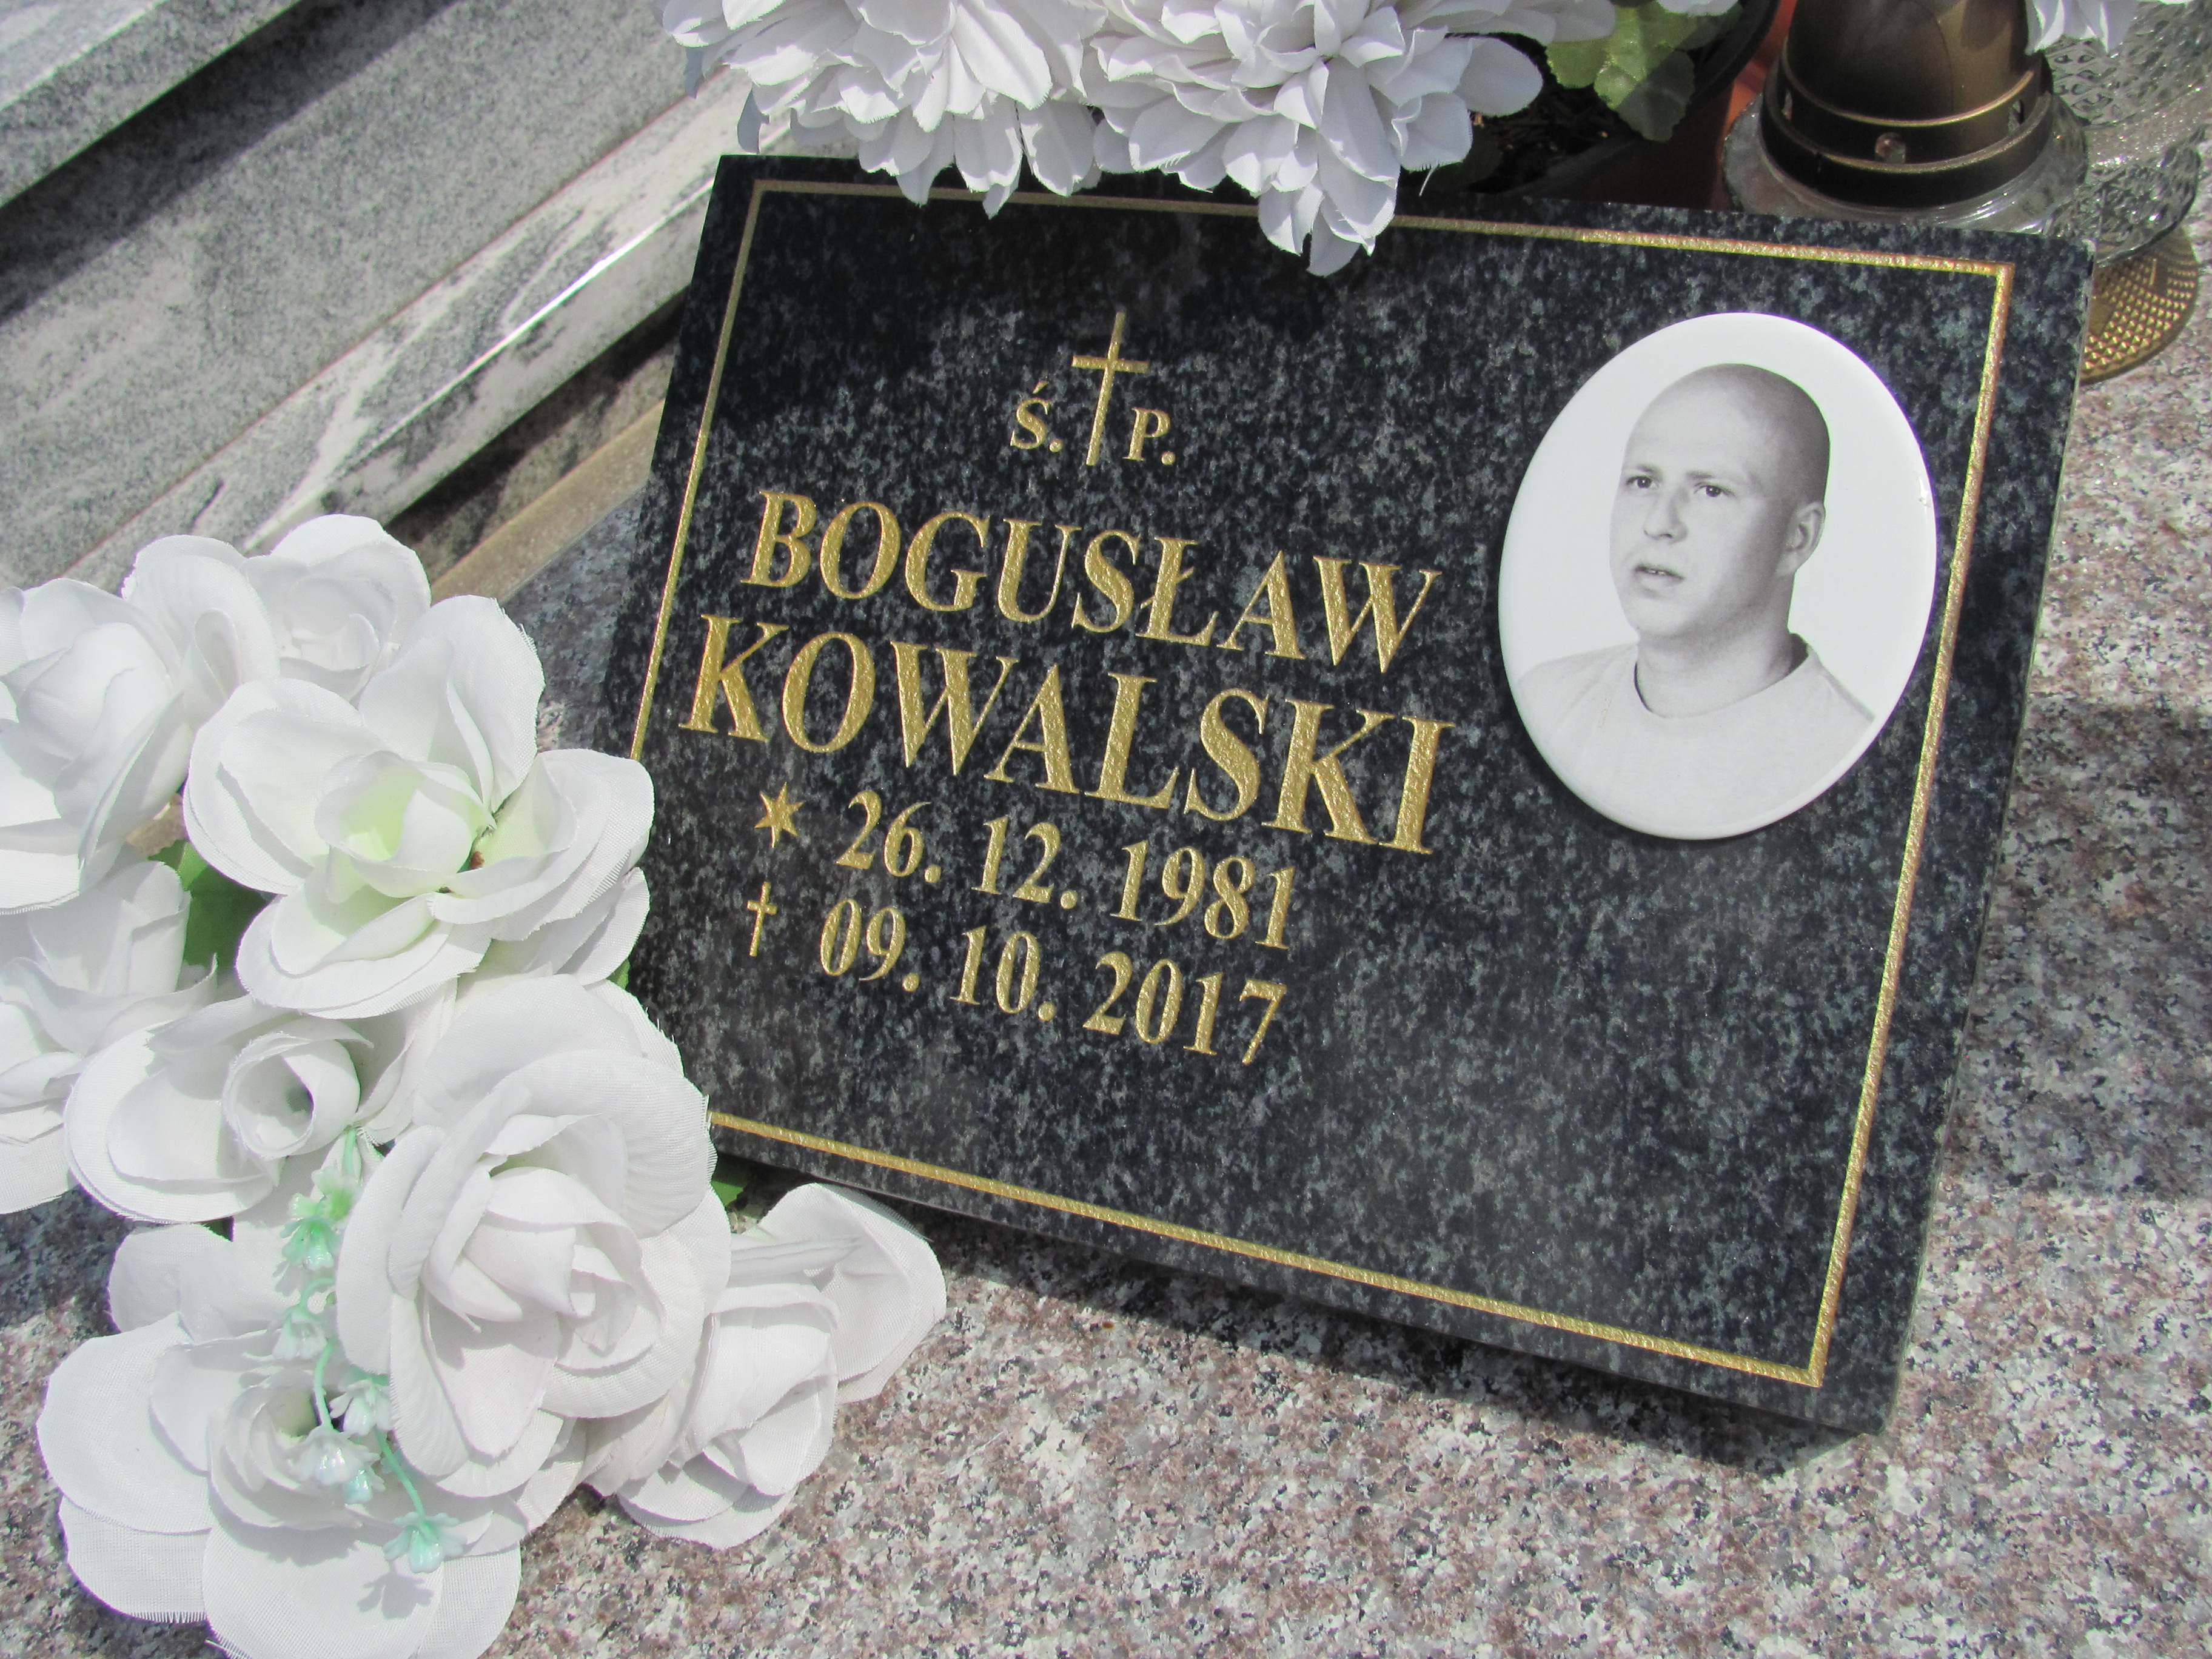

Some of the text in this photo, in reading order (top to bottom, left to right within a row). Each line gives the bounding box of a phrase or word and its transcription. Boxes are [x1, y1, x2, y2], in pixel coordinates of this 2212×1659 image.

[1009, 380, 1177, 466] Ś. P.
[740, 490, 1443, 674] BOGUSŁAW
[677, 613, 1456, 855] KOWALSKI
[834, 789, 1296, 950] 26. 12. 1981
[818, 897, 1287, 1065] 09. 10. 2017
